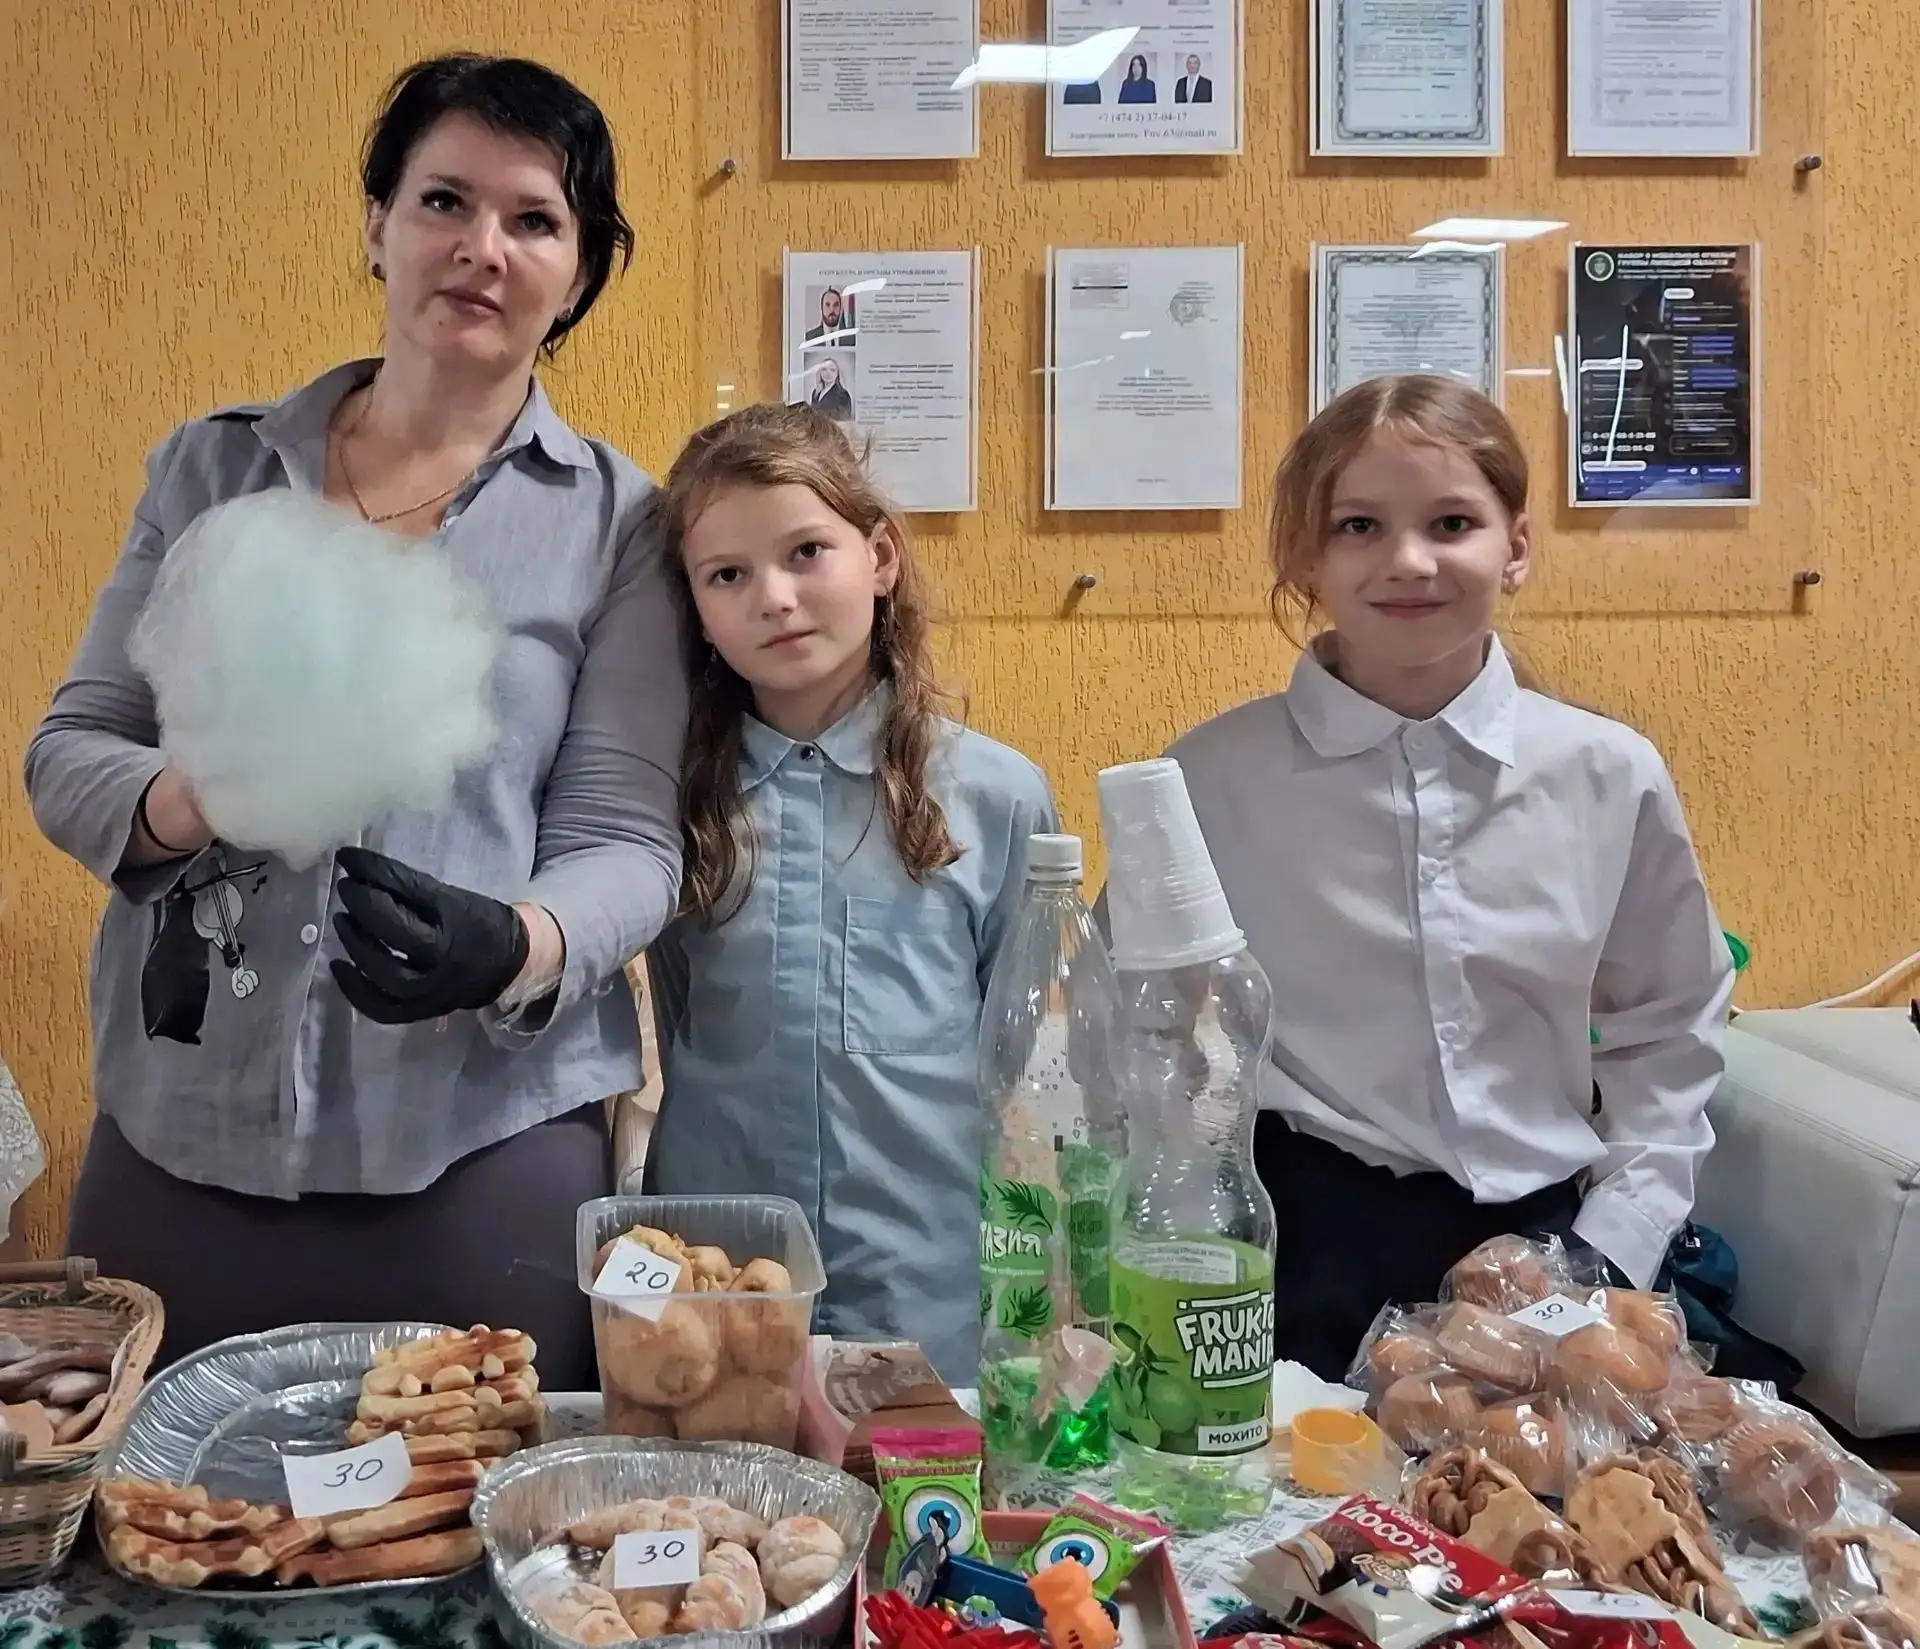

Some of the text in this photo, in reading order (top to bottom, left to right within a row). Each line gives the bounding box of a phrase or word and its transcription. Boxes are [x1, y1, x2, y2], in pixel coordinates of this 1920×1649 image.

[625, 1261, 669, 1289] 20
[1535, 1303, 1564, 1320] 30
[1208, 1425, 1263, 1444] МОХИТО
[323, 1459, 383, 1487] 30
[637, 1540, 685, 1564] 30
